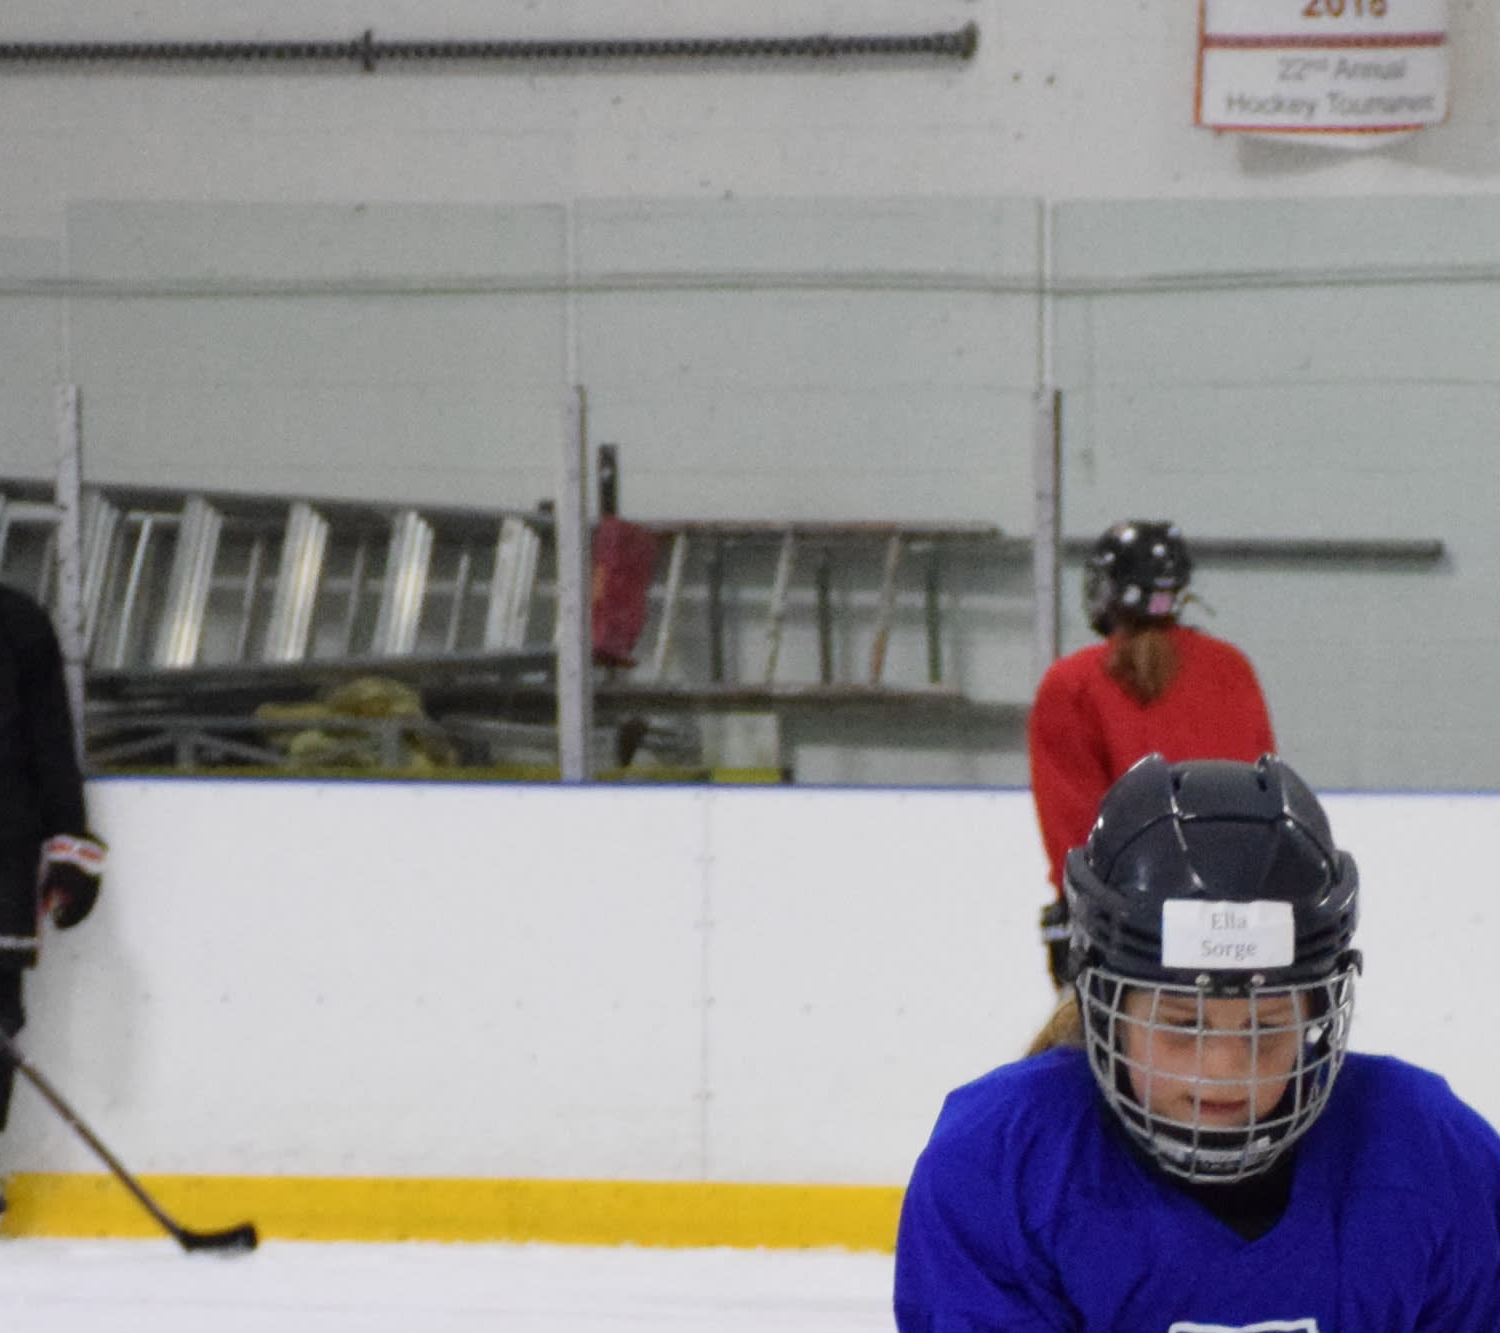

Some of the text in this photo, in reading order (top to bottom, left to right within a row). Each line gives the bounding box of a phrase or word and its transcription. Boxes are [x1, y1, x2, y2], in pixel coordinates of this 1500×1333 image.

[1225, 92, 1317, 119] Hockey
[1211, 912, 1249, 930] Ella
[1200, 940, 1258, 961] Sorge
